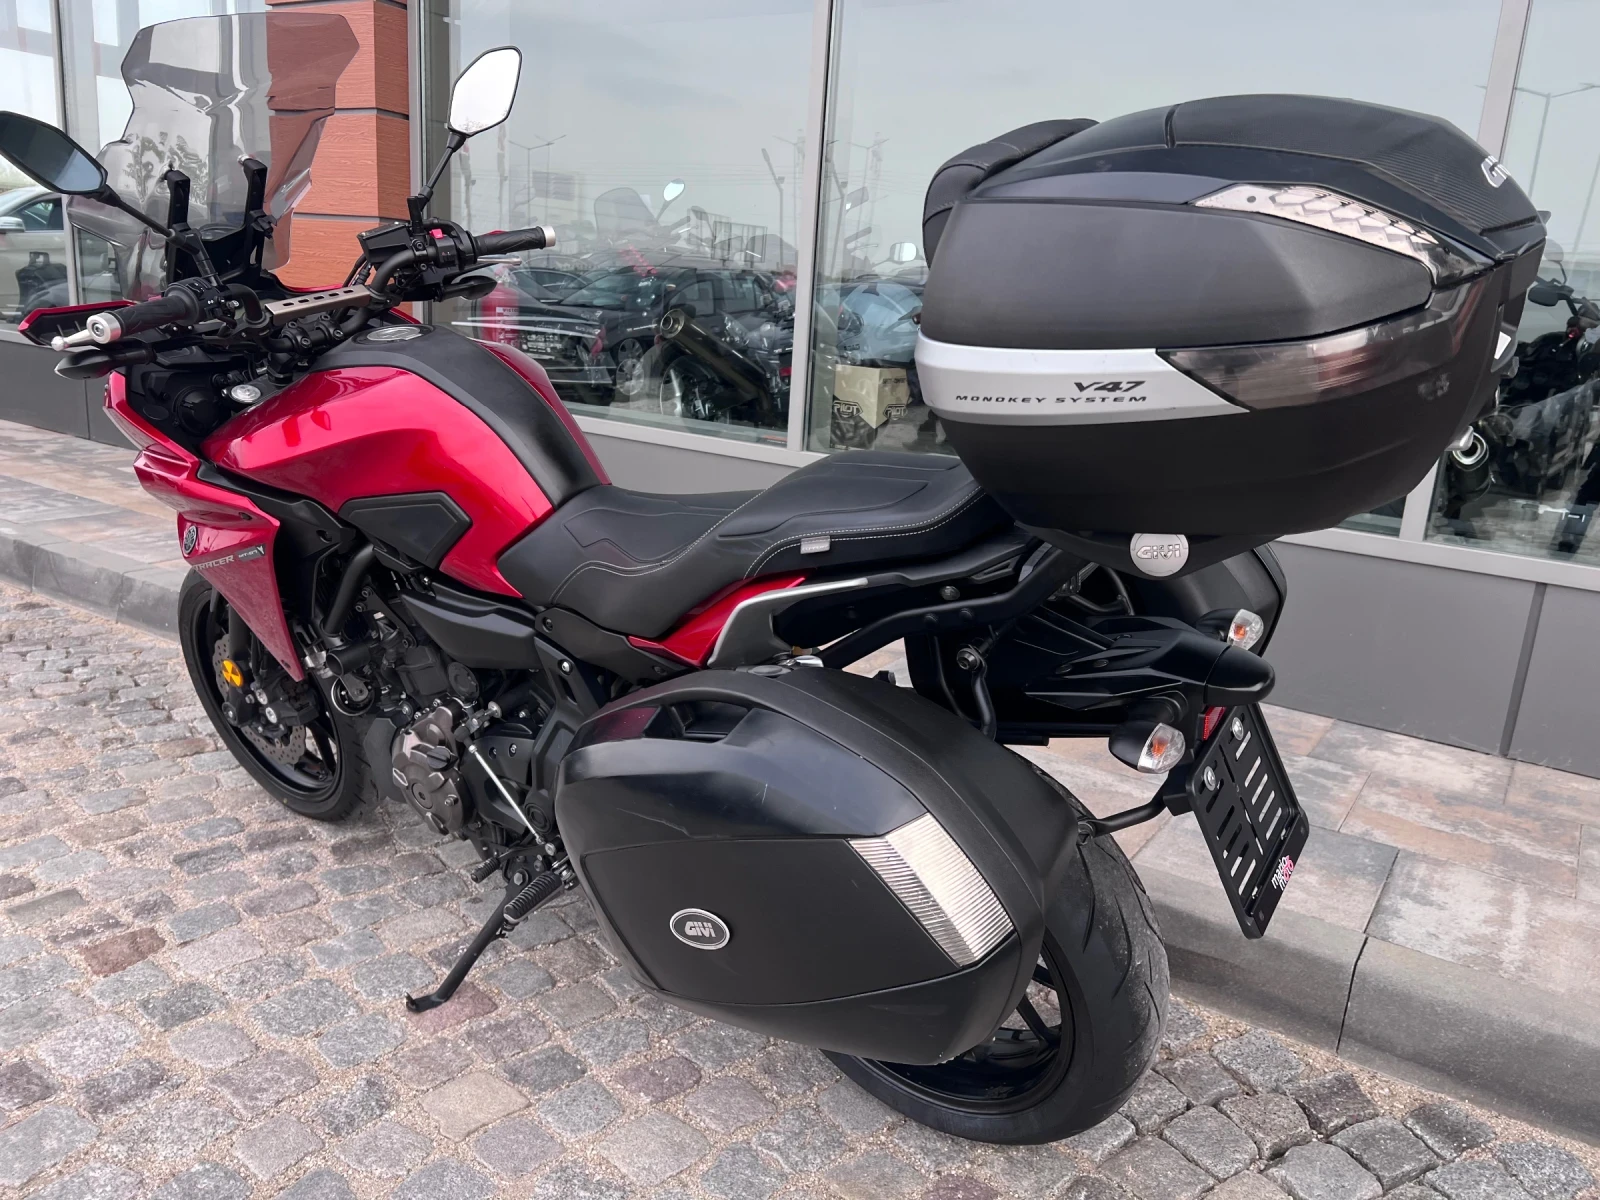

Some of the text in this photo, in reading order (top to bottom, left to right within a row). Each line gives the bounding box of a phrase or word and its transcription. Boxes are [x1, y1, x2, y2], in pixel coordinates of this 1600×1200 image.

[1073, 380, 1147, 393] V47
[955, 395, 1147, 404] MONOKEY SYSTEM
[193, 554, 235, 571] TRACER
[684, 921, 717, 938] GIVI
